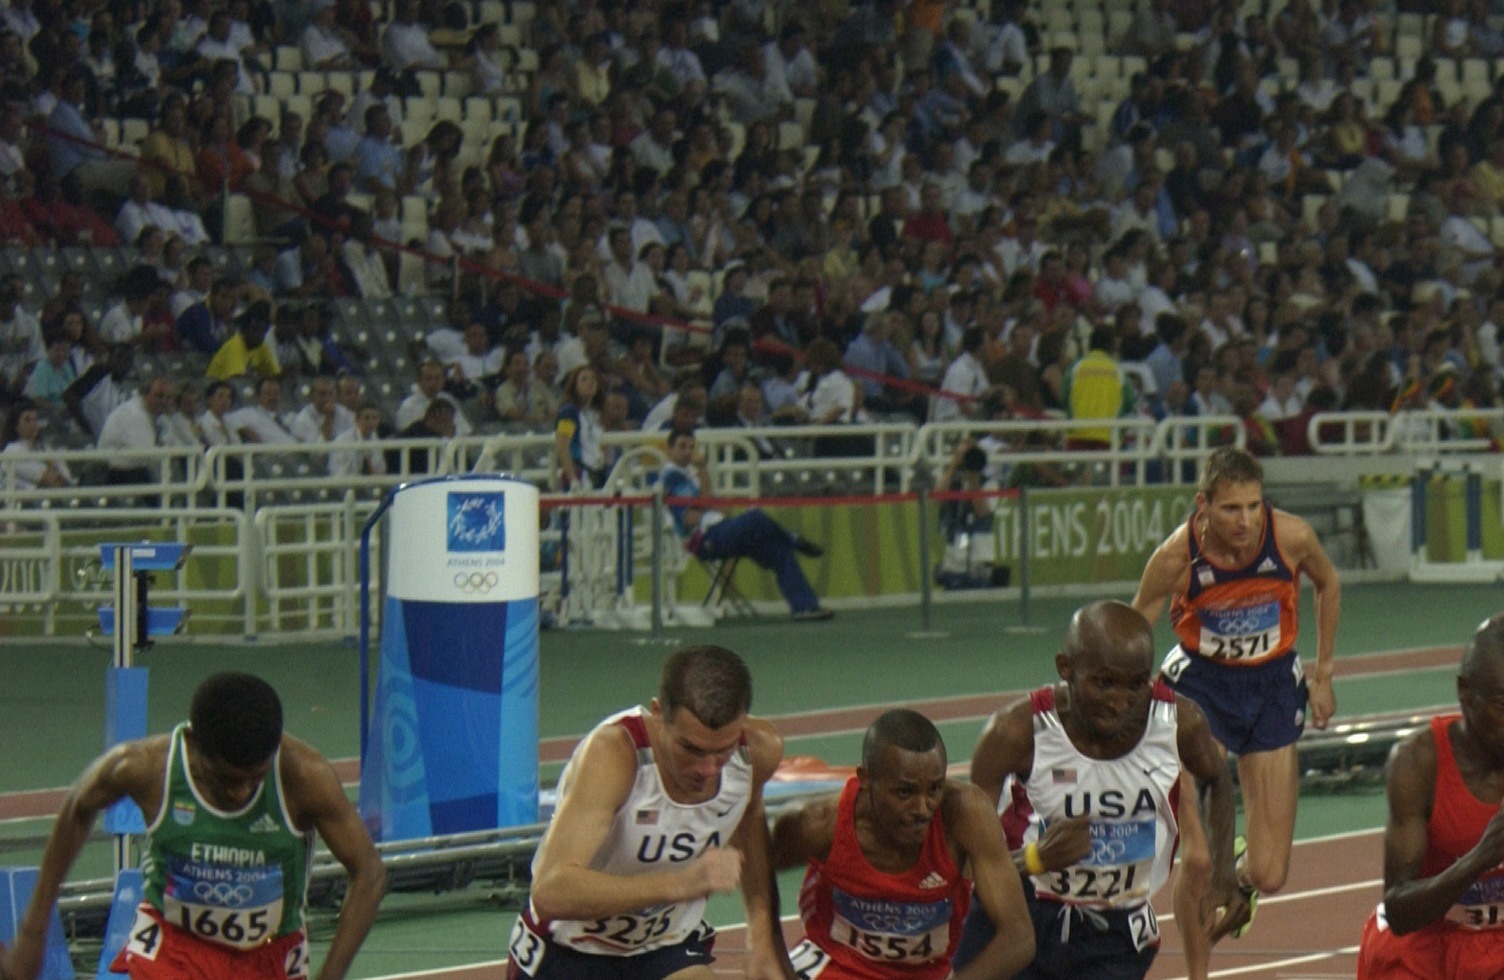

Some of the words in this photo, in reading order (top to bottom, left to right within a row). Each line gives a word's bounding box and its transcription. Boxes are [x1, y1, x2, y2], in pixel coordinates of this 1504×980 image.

[1097, 499, 1163, 554] 2004
[1211, 633, 1268, 658] 2571
[1065, 788, 1157, 818] USA
[192, 843, 265, 866] ETHIOPIA
[182, 863, 232, 881] ATHENS
[1050, 864, 1136, 898] 3221
[135, 922, 159, 954] 4
[179, 904, 268, 943] 1665
[849, 928, 933, 960] 1554
